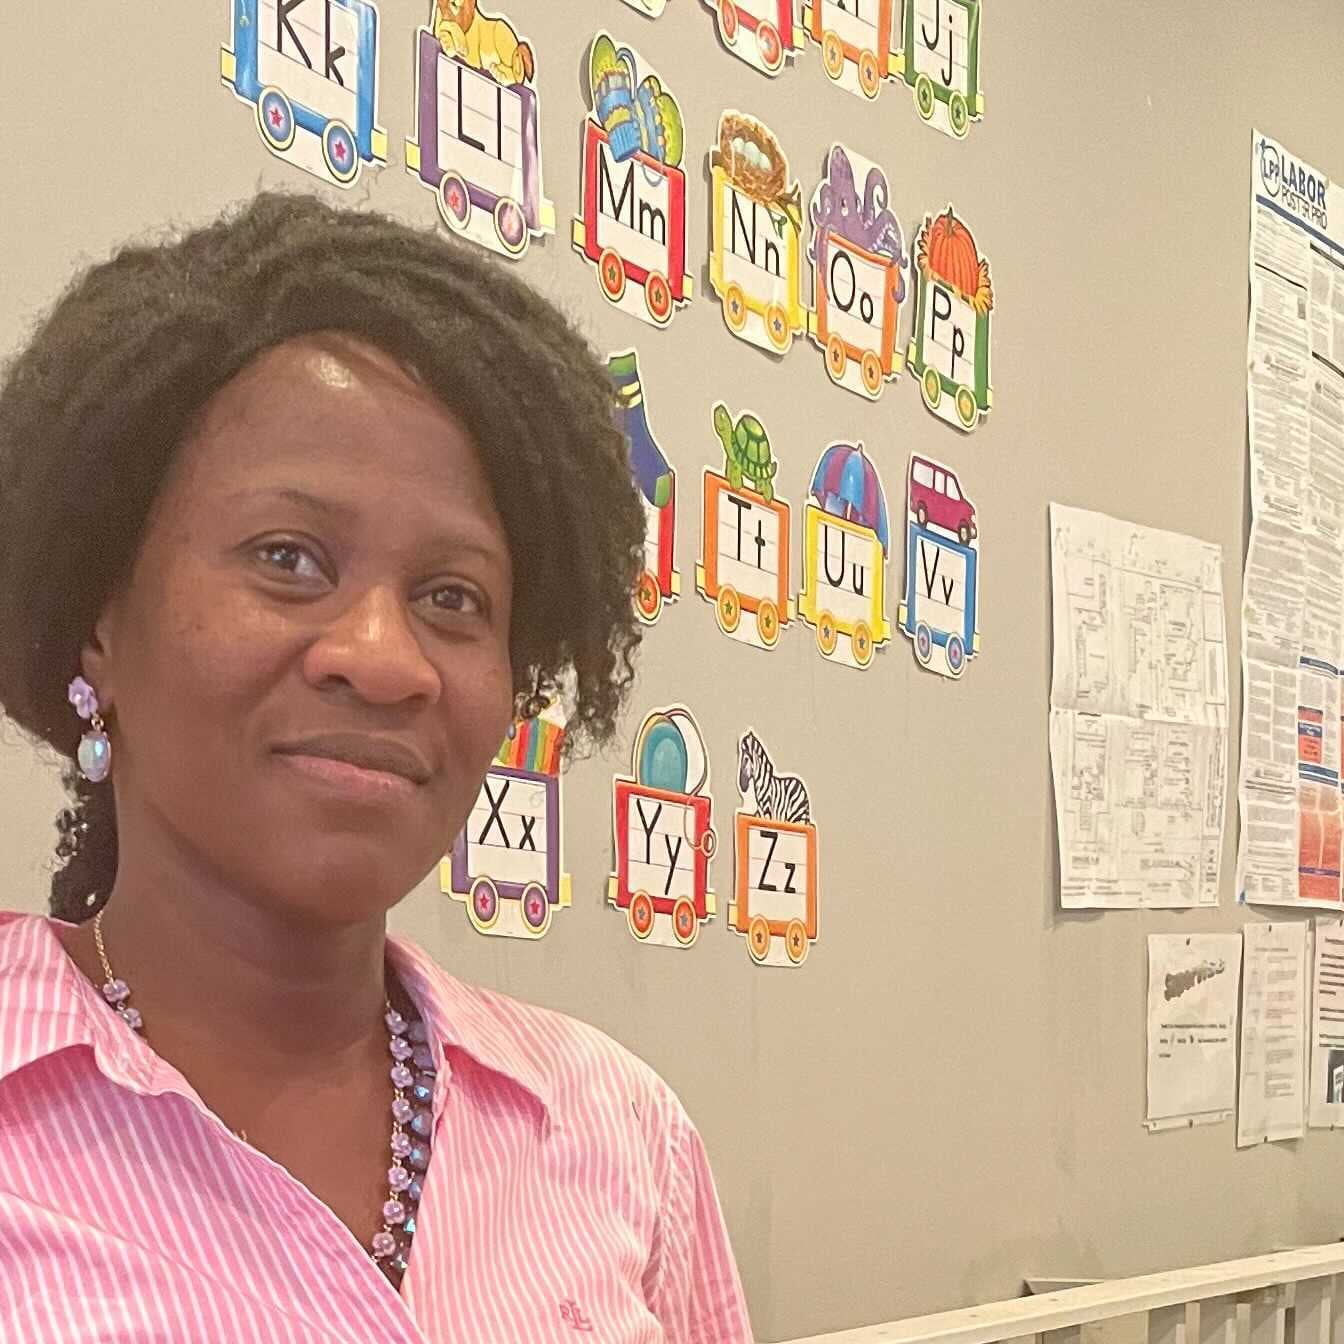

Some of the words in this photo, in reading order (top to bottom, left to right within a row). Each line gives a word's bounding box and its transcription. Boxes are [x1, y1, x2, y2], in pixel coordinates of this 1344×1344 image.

[599, 140, 667, 247] Mm
[1280, 153, 1327, 211] LABOR
[731, 188, 781, 278] Nn
[829, 250, 874, 325] Oo
[930, 286, 965, 378] Pp
[727, 495, 766, 570] Tt
[823, 523, 865, 596] Uu
[919, 540, 955, 606] Vv
[478, 779, 537, 852] Xx
[635, 798, 682, 896] Yy
[758, 829, 797, 894] Zz
